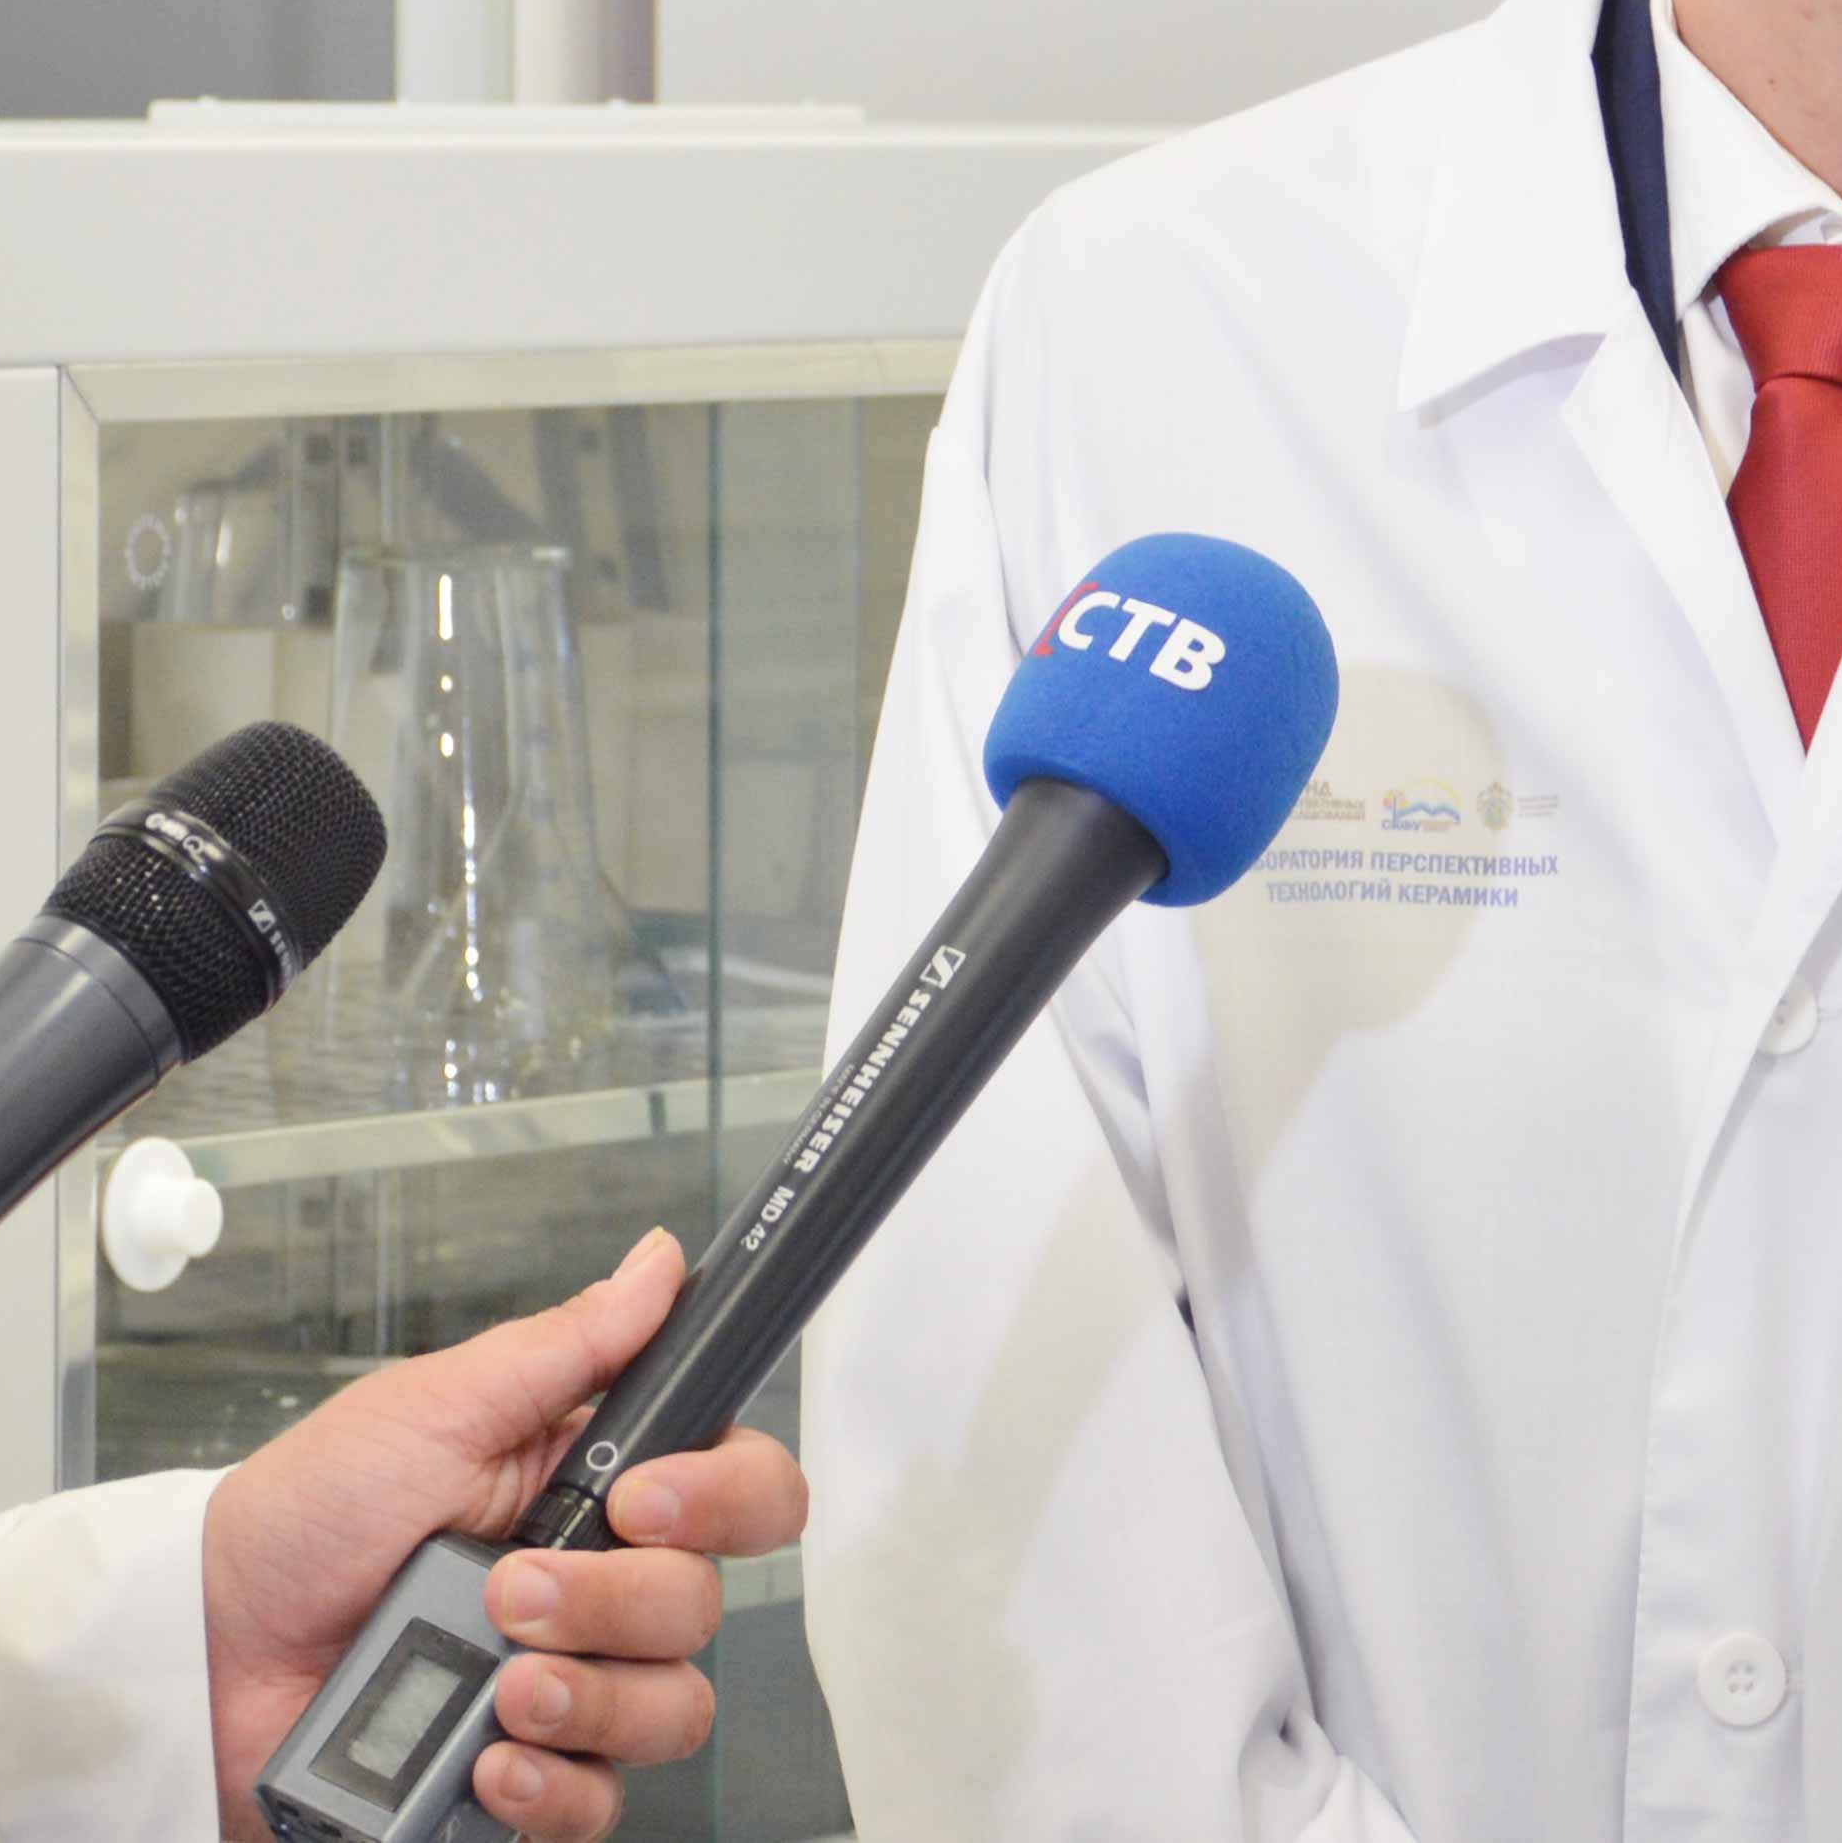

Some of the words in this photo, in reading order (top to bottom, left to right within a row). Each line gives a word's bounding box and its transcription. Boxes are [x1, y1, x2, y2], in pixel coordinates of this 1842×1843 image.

[1255, 848, 1363, 871] ОРАТОРИЯ
[1370, 852, 1559, 876] ПЕРСПЕКТИВНЫХ
[1266, 877, 1391, 903] ТЕХНОЛОГИЙ
[1398, 884, 1519, 907] КЕРАМИКИ
[794, 989, 932, 1174] SENNHEISER
[760, 1185, 796, 1224] MD
